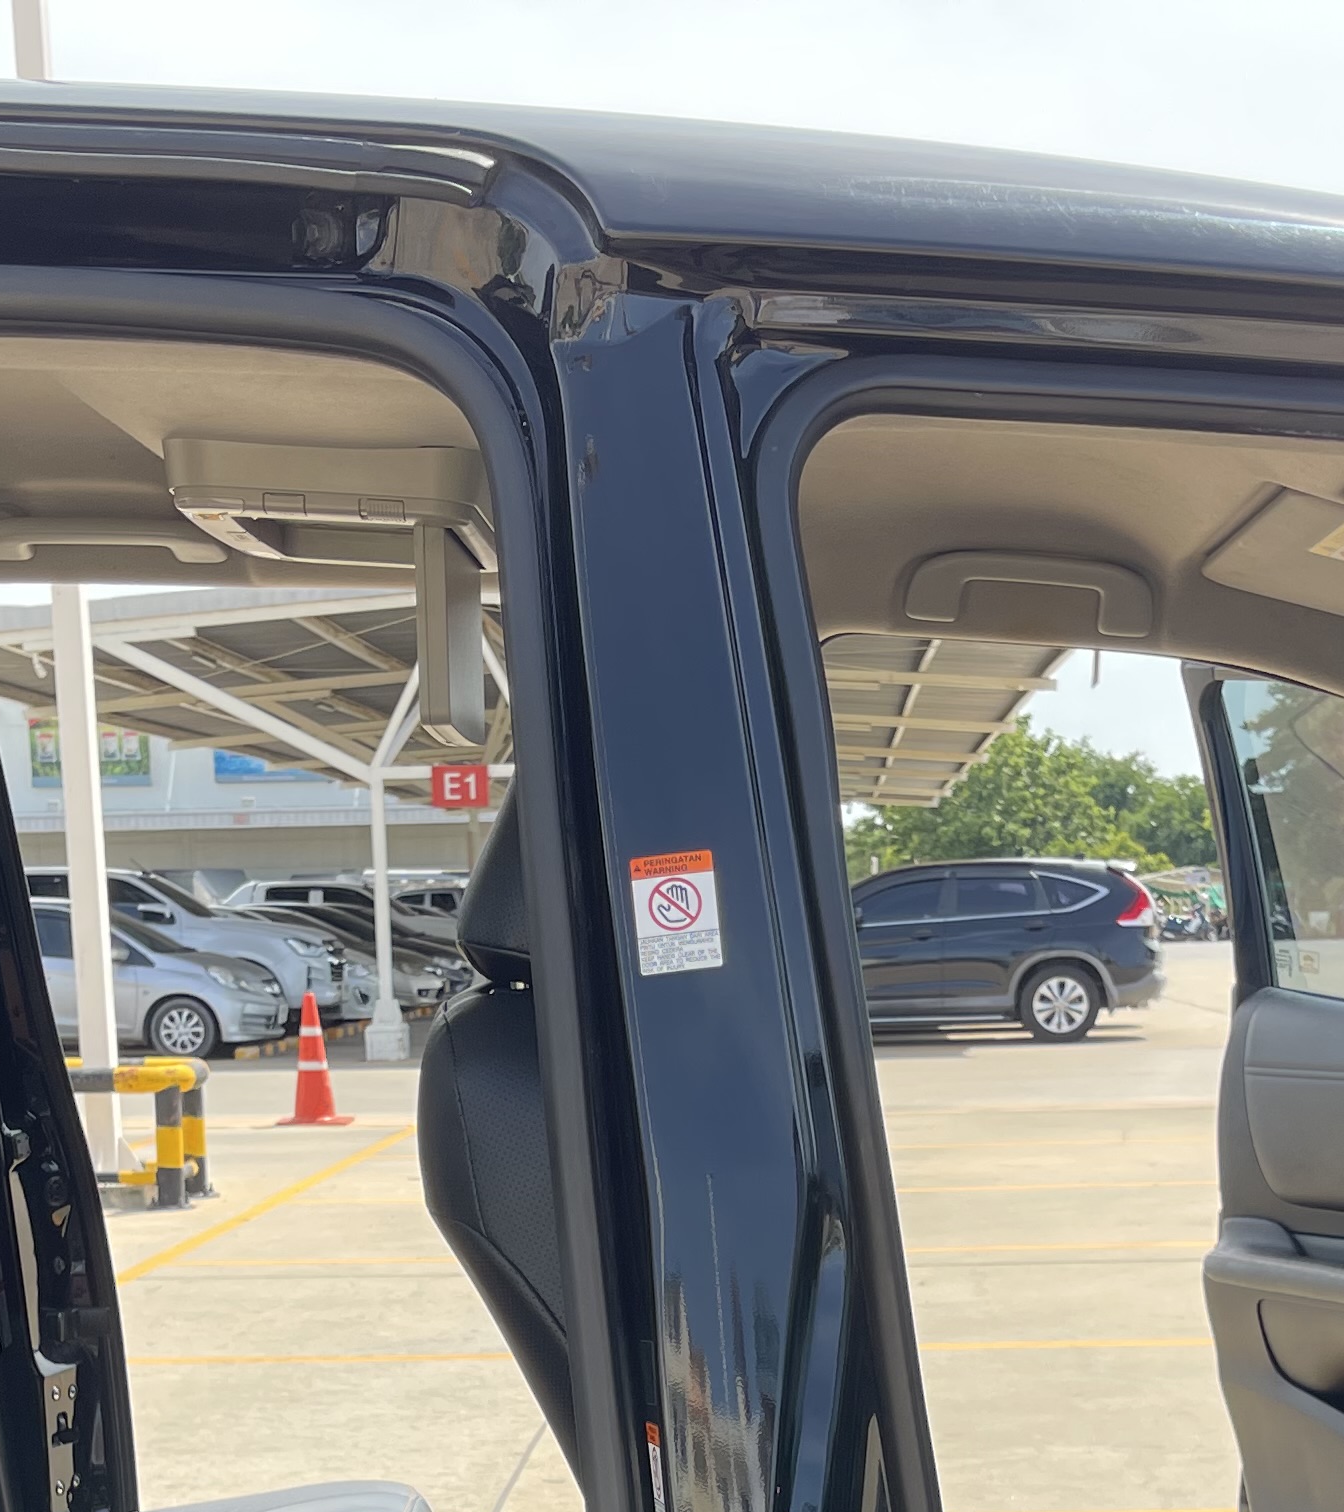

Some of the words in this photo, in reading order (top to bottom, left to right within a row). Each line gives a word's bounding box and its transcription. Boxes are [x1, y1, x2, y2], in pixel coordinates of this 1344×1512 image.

[443, 772, 477, 801] E1
[643, 854, 702, 867] PERINGATAN
[644, 863, 688, 876] WARNING
